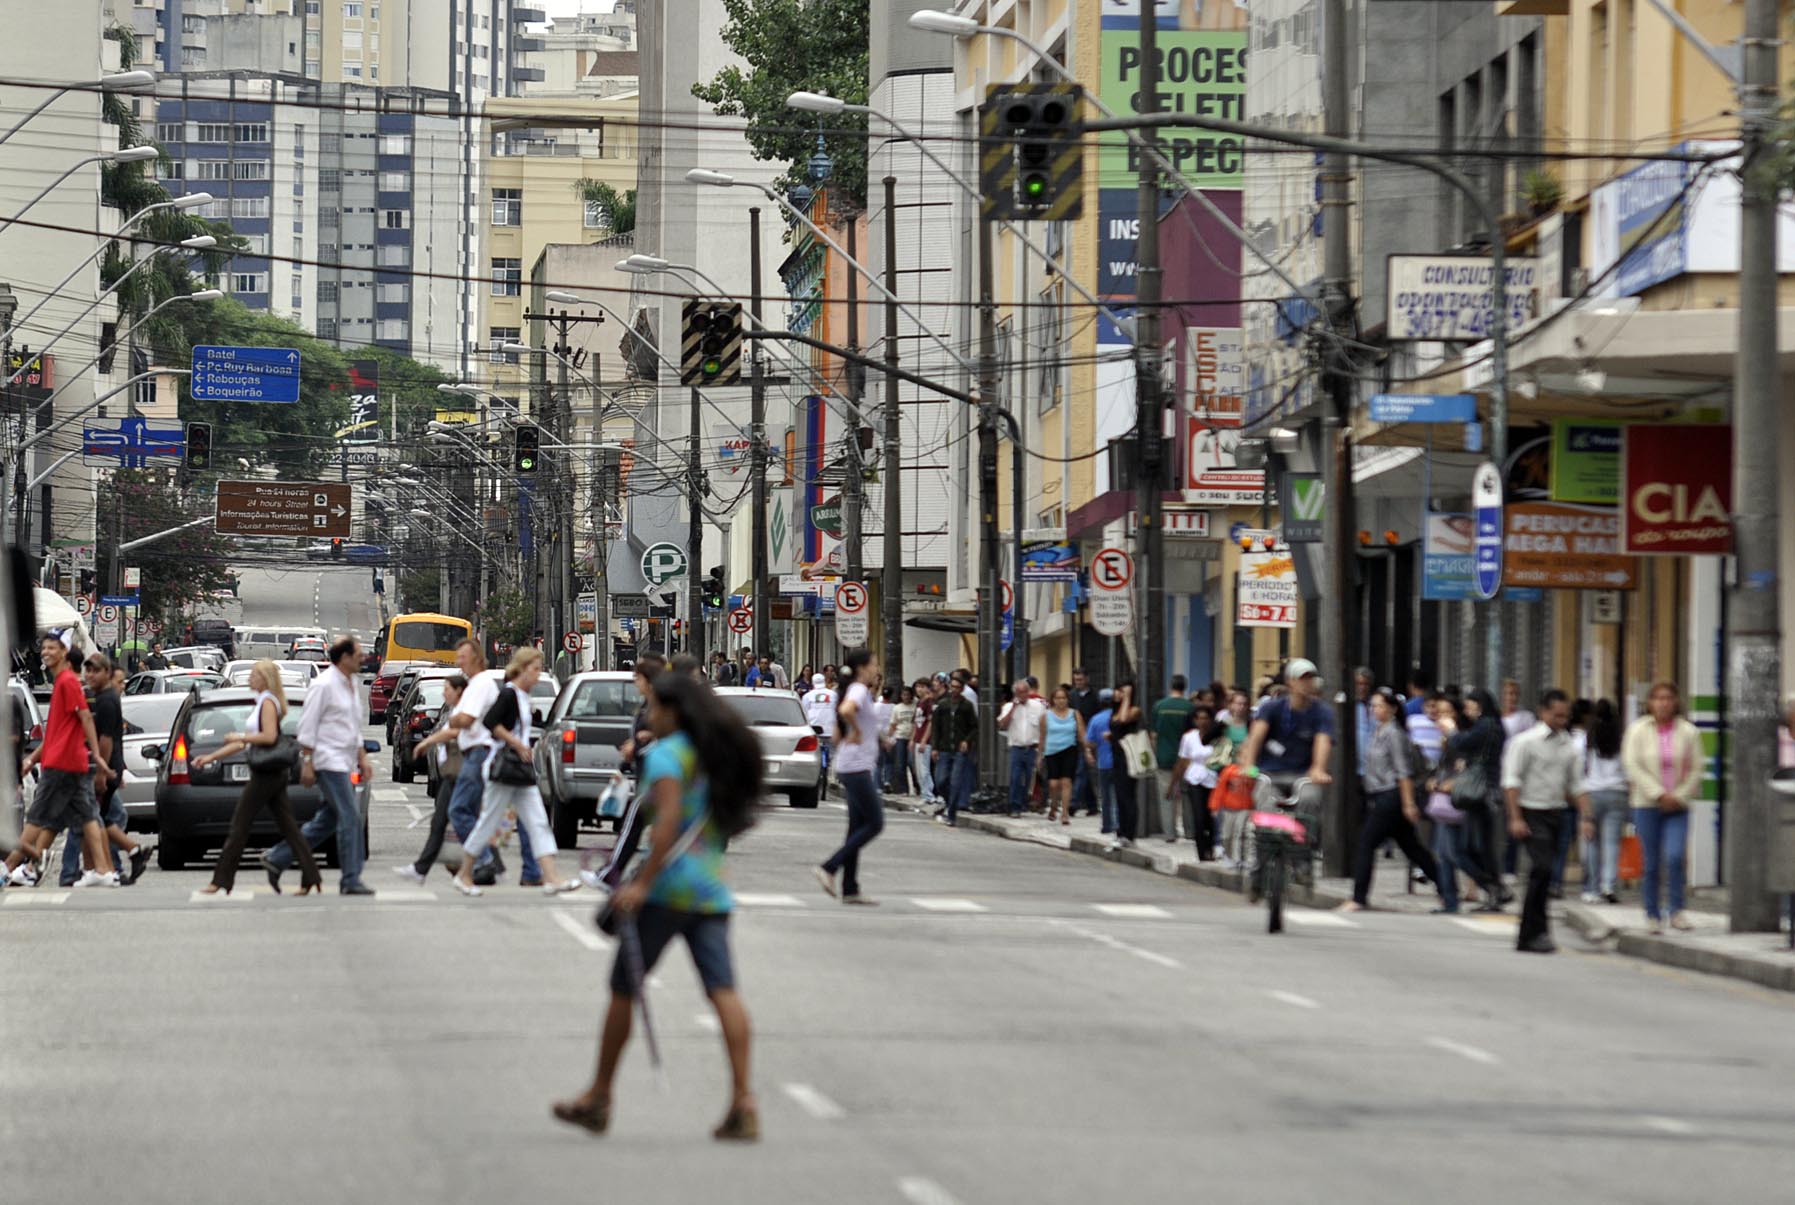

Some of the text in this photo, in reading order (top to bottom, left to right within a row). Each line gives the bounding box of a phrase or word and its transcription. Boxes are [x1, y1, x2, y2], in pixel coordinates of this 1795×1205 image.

[1109, 219, 1140, 240] INS
[1423, 265, 1534, 286] CONSULTRIO
[207, 349, 236, 360] Batel
[224, 362, 245, 374] Ruy
[246, 364, 293, 375] Barbosa
[207, 373, 261, 386] Rebouças
[207, 386, 263, 398] Boqueirão
[247, 499, 309, 509] 24 hours Street
[1633, 482, 1731, 524] CIA
[220, 510, 309, 521] Informações Turísticas
[237, 521, 261, 530] Tourist
[651, 549, 682, 583] P
[77, 599, 85, 612] E
[105, 607, 112, 619] E
